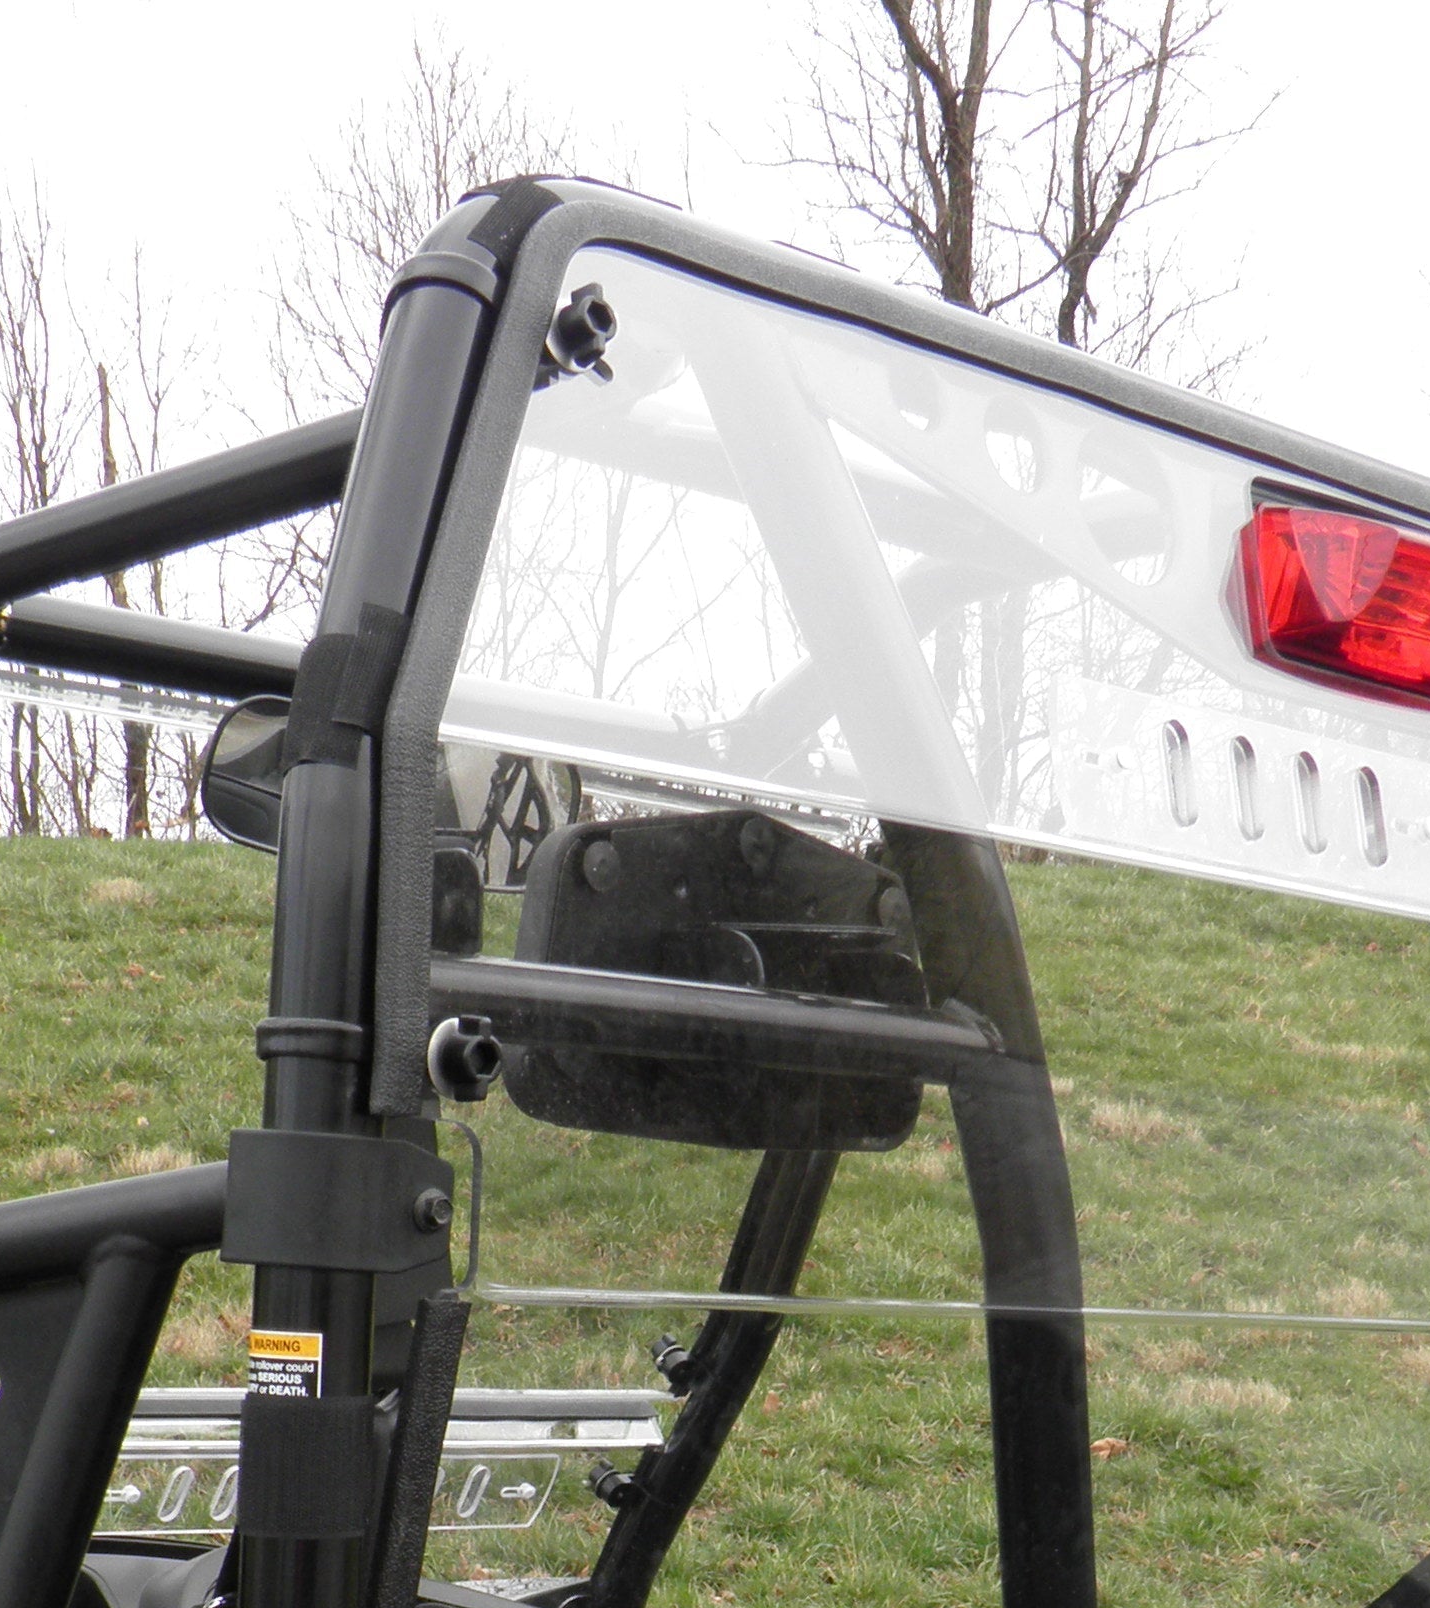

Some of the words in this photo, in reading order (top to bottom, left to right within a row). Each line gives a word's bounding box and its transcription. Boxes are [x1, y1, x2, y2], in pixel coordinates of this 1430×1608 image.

[254, 1338, 300, 1352] WARNING
[285, 1363, 314, 1373] could
[258, 1372, 302, 1384] SERIOUS
[269, 1384, 309, 1397] DEATH.
